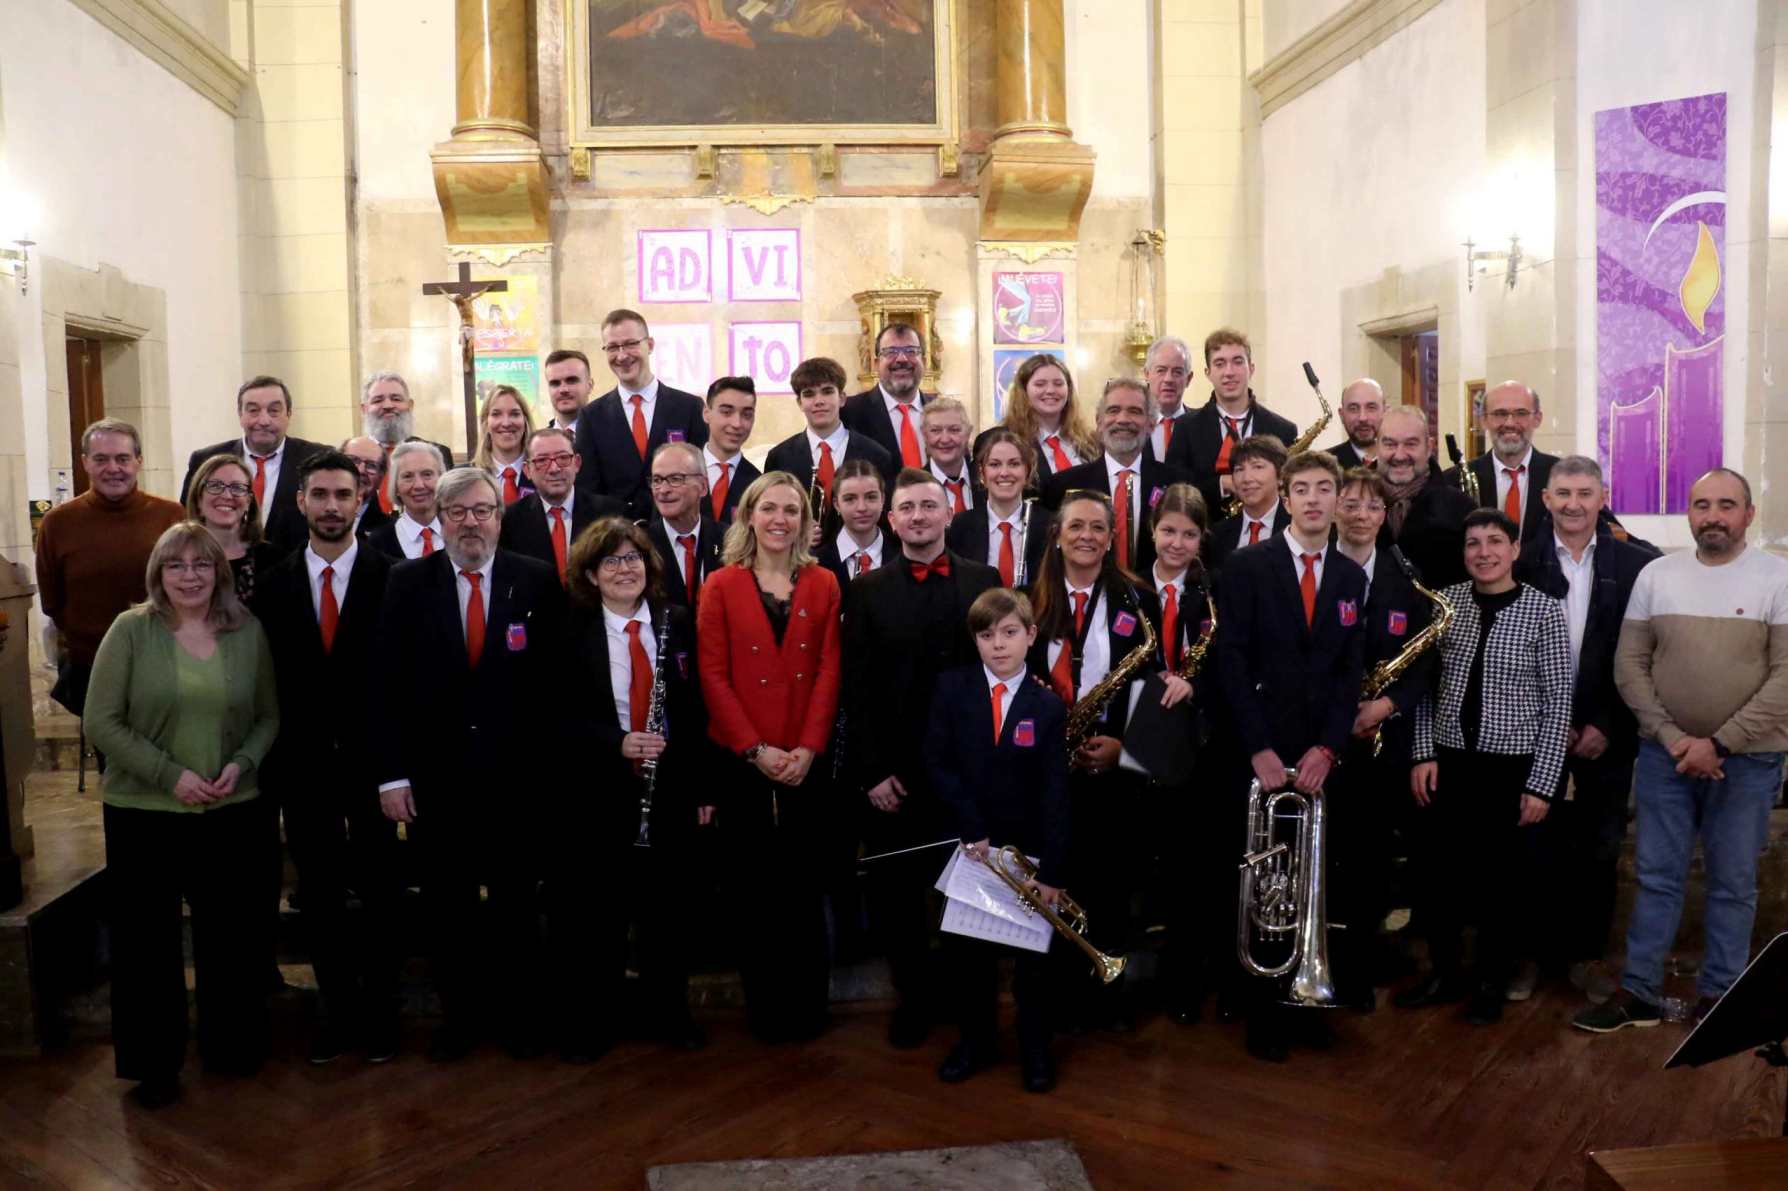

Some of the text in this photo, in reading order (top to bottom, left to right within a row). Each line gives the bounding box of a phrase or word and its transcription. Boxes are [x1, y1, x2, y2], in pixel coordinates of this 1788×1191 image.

[650, 245, 788, 292] AD VI
[656, 335, 791, 386] EN TO
